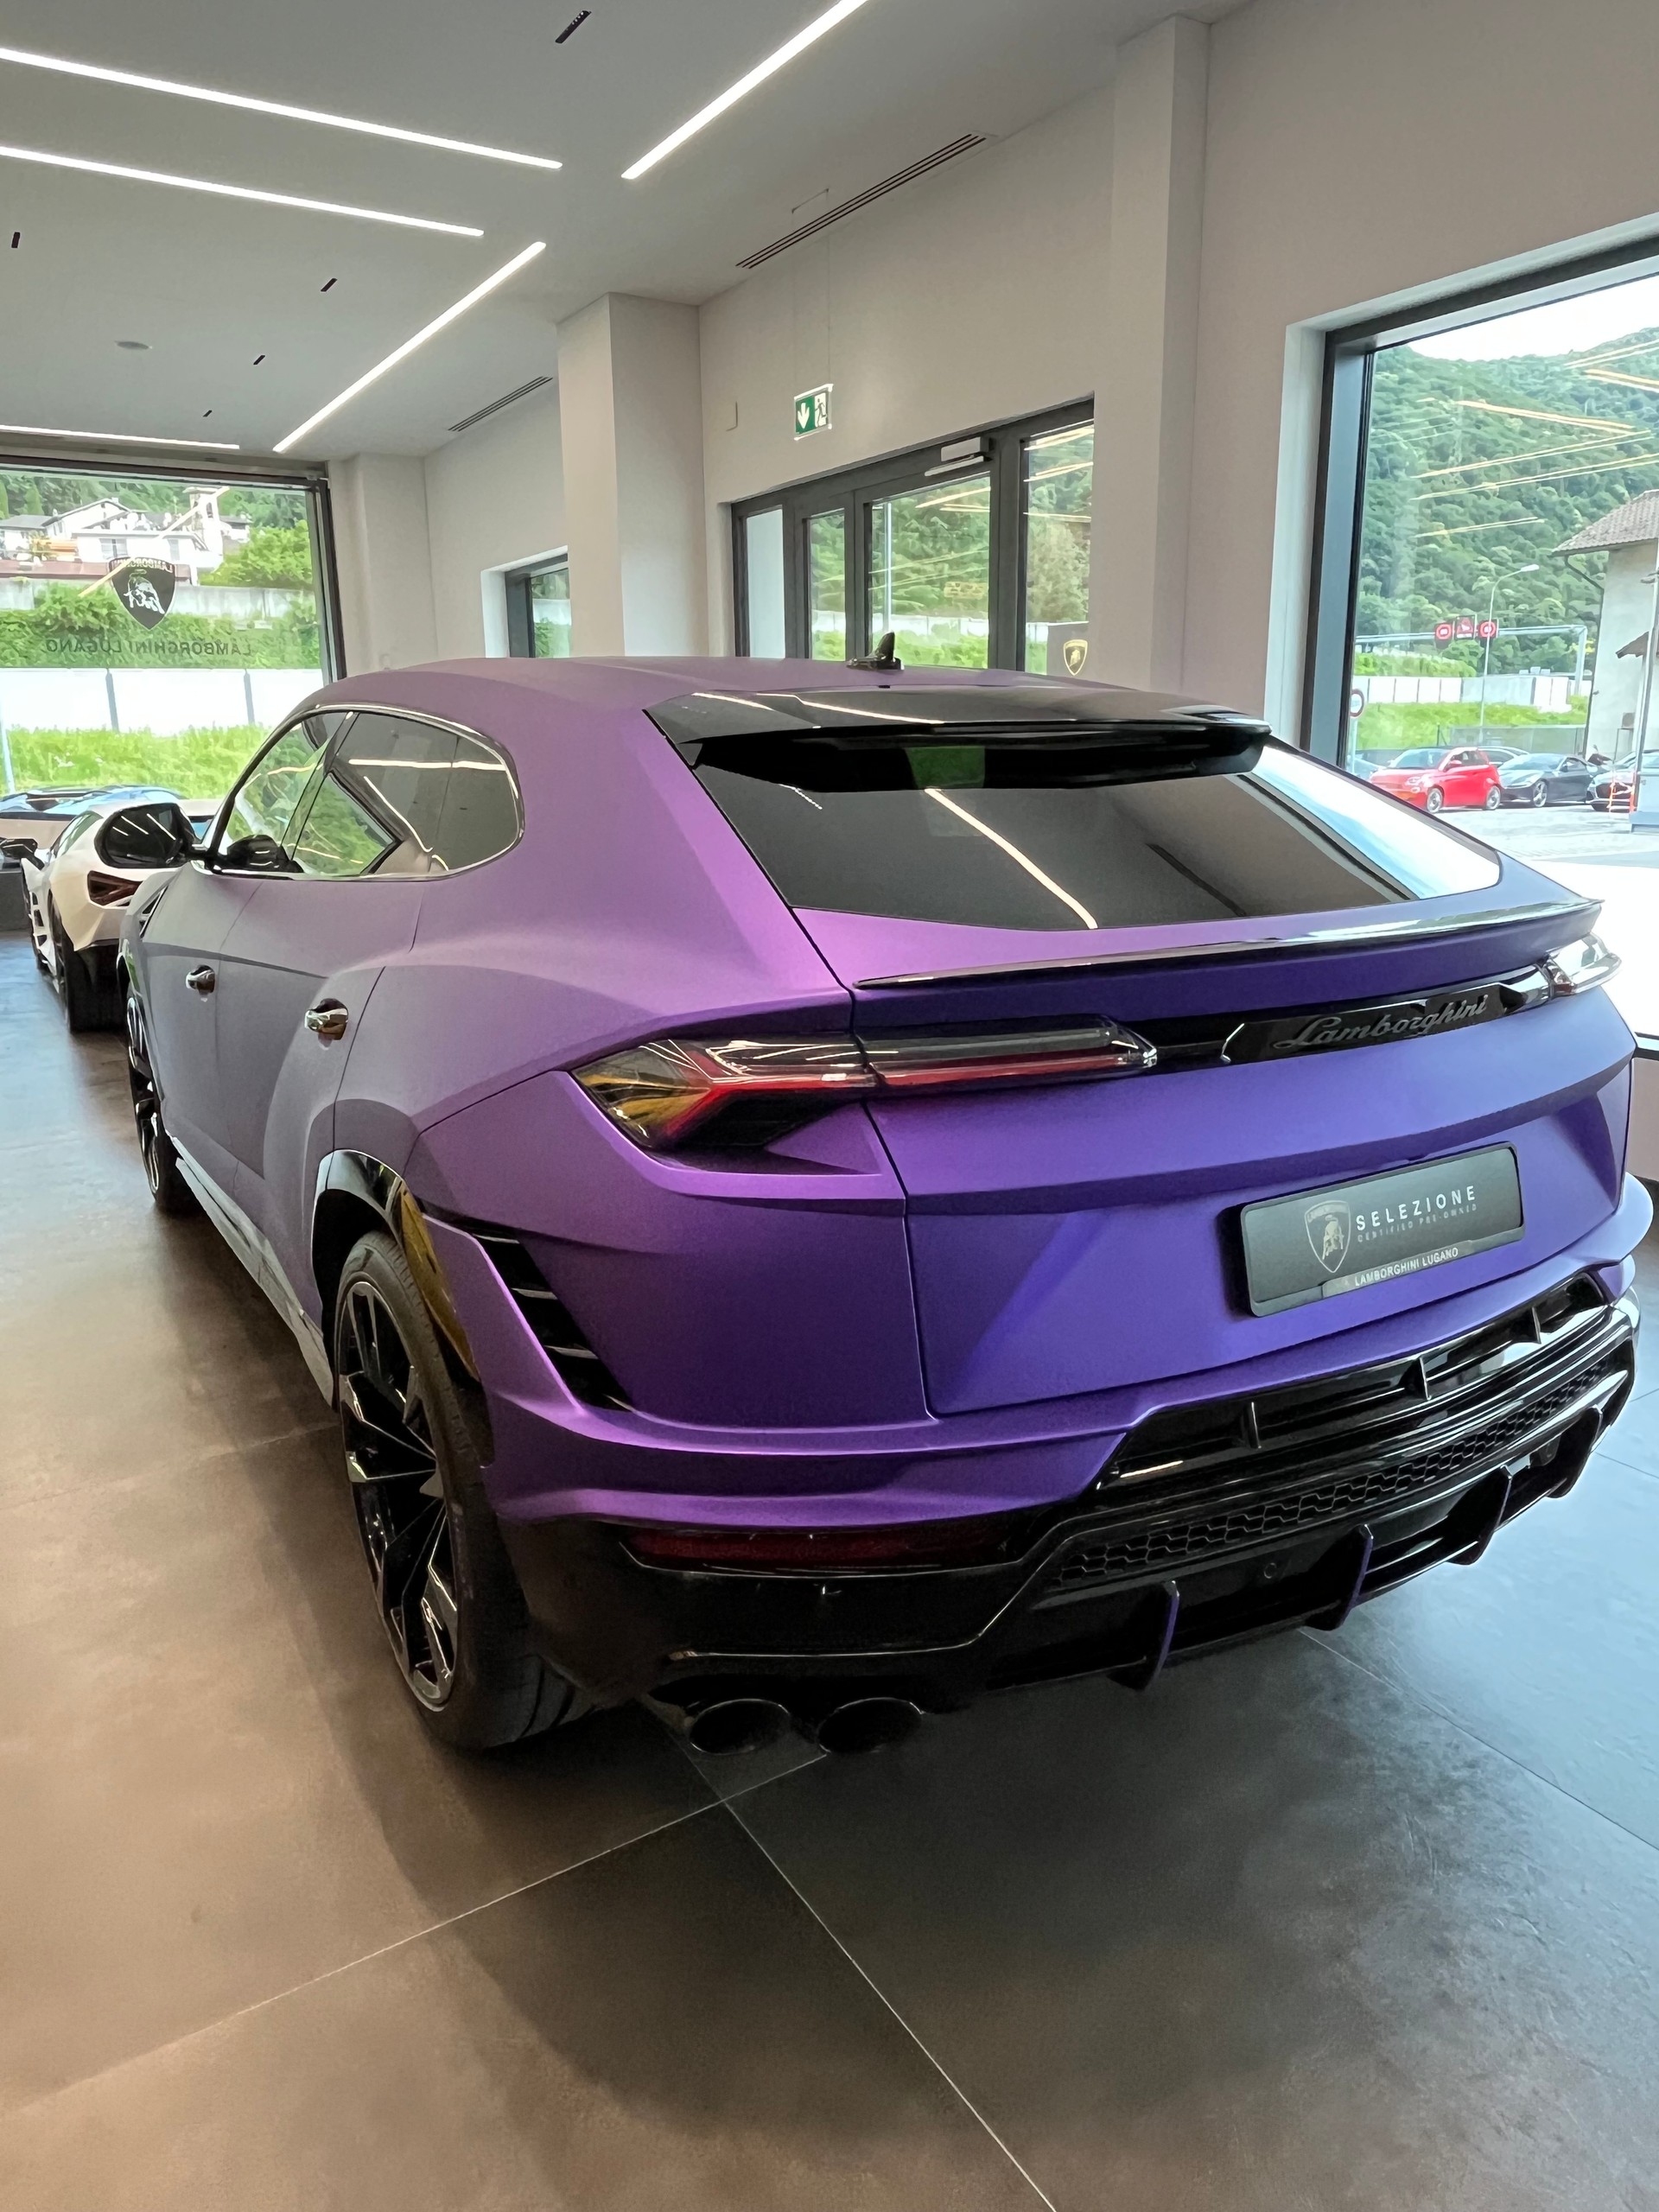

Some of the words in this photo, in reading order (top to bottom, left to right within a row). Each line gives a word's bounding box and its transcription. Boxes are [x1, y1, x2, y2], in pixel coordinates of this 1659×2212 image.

[1273, 994, 1489, 1049] Lamborghini
[1356, 1185, 1476, 1231] SELEZIONE
[1354, 1258, 1420, 1287] LAMBORGHINI
[1421, 1247, 1459, 1267] LUGANO
